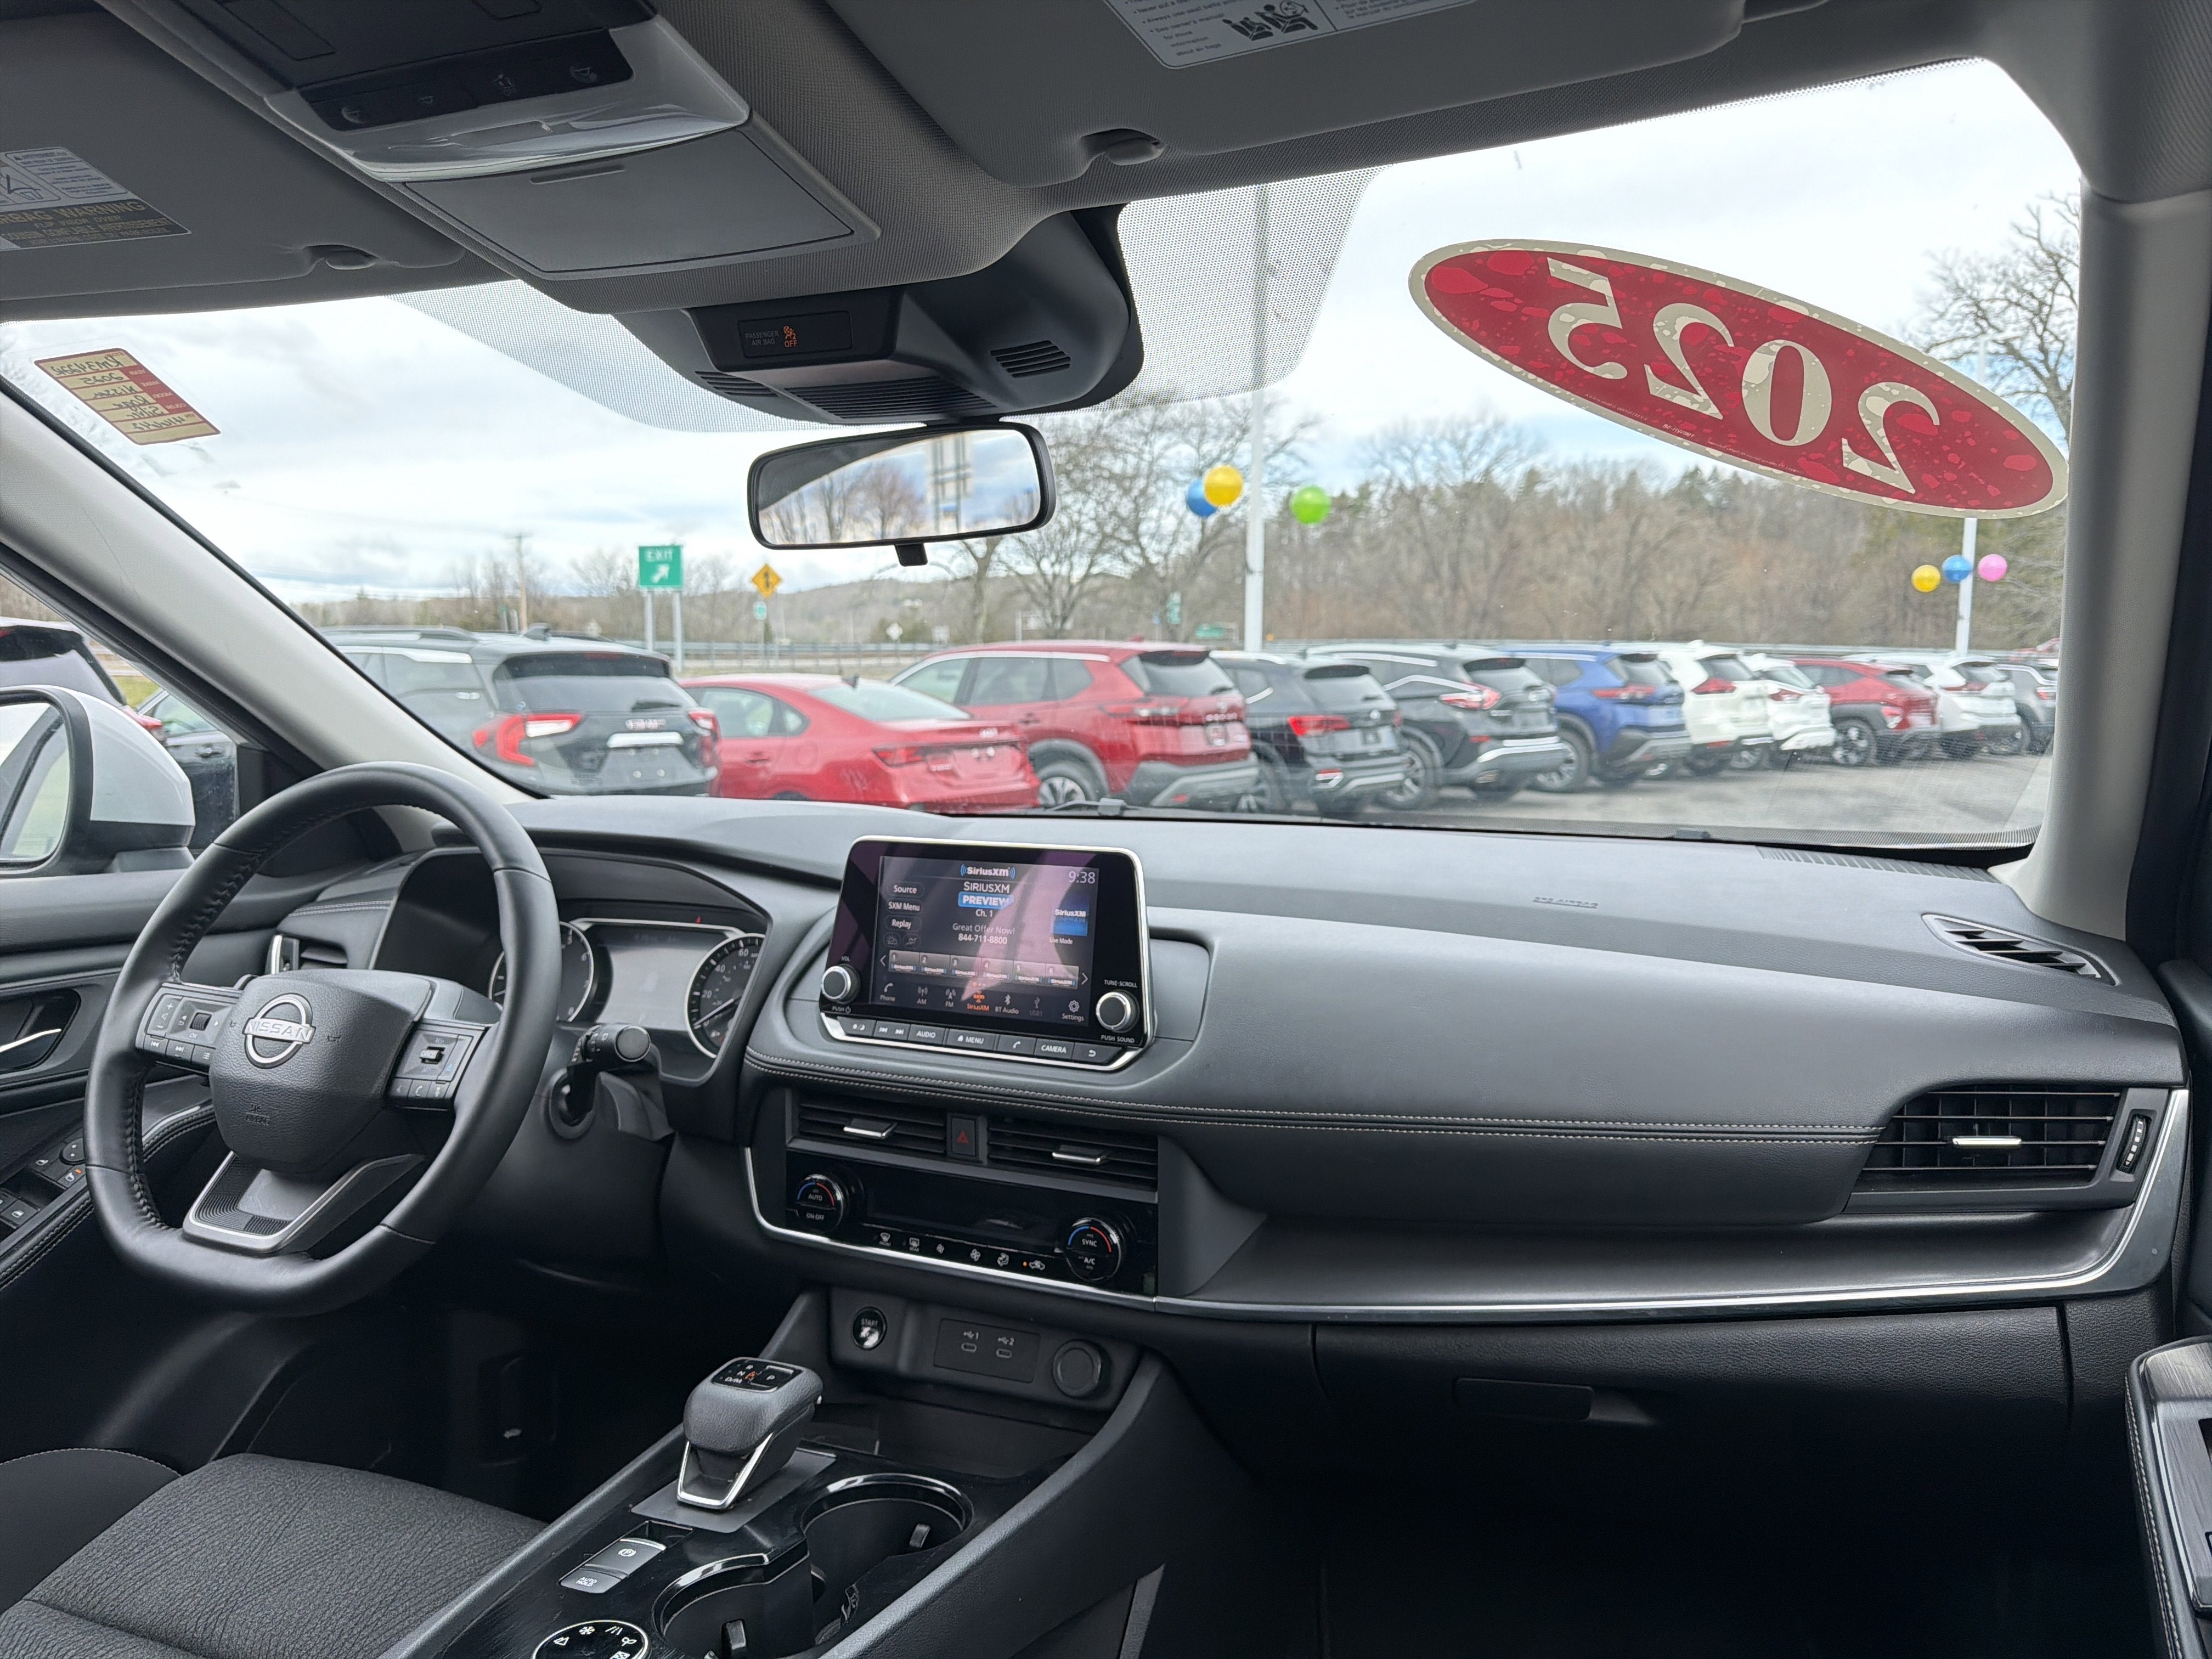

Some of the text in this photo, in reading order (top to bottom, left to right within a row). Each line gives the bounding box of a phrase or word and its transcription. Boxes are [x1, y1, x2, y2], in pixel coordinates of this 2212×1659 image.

[54, 201, 146, 218] WARNING
[745, 330, 779, 339] PASSENGER
[752, 338, 761, 346] AIR
[784, 340, 798, 348] OFF
[645, 549, 673, 562] EXIT
[1069, 871, 1096, 884] 9:38
[894, 884, 917, 894] Source
[963, 881, 1010, 894] SIRIUSXM
[962, 895, 1009, 906] PREVIEW
[888, 901, 920, 911] SXM Menu
[975, 909, 988, 917] Ch.
[1054, 909, 1086, 918] SiriusXM
[891, 919, 912, 930] Replay
[952, 923, 1015, 935] Great Offer Now!
[958, 933, 1008, 945] 844-711-8800
[739, 949, 749, 957] 60
[715, 964, 726, 973] 40
[702, 990, 712, 998] 20
[967, 1003, 990, 1011] SiriusXM
[1062, 1013, 1084, 1022] Settings
[247, 1021, 312, 1041] NISSAN
[916, 1030, 936, 1039] AUDIO
[966, 1036, 984, 1045] MENU
[1041, 1045, 1066, 1054] CAMERA
[1082, 1238, 1097, 1247] SYNC
[1084, 1257, 1096, 1265] A/C
